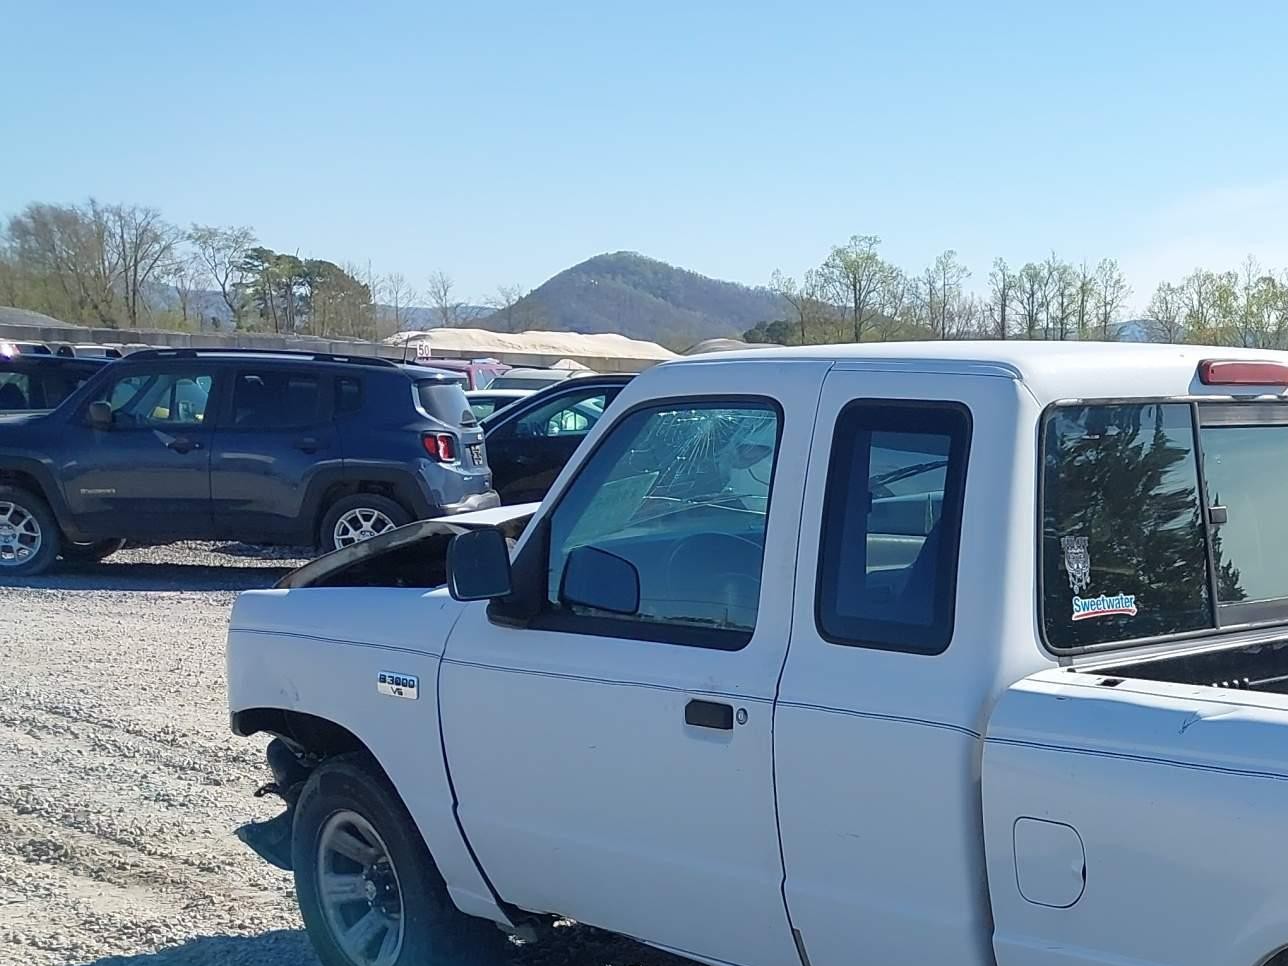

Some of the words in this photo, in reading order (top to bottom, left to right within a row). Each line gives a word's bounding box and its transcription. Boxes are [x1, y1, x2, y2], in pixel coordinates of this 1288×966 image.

[418, 344, 430, 356] 50
[1073, 594, 1134, 613] Sweetwater
[379, 673, 415, 689] B3000
[390, 686, 404, 696] V6
